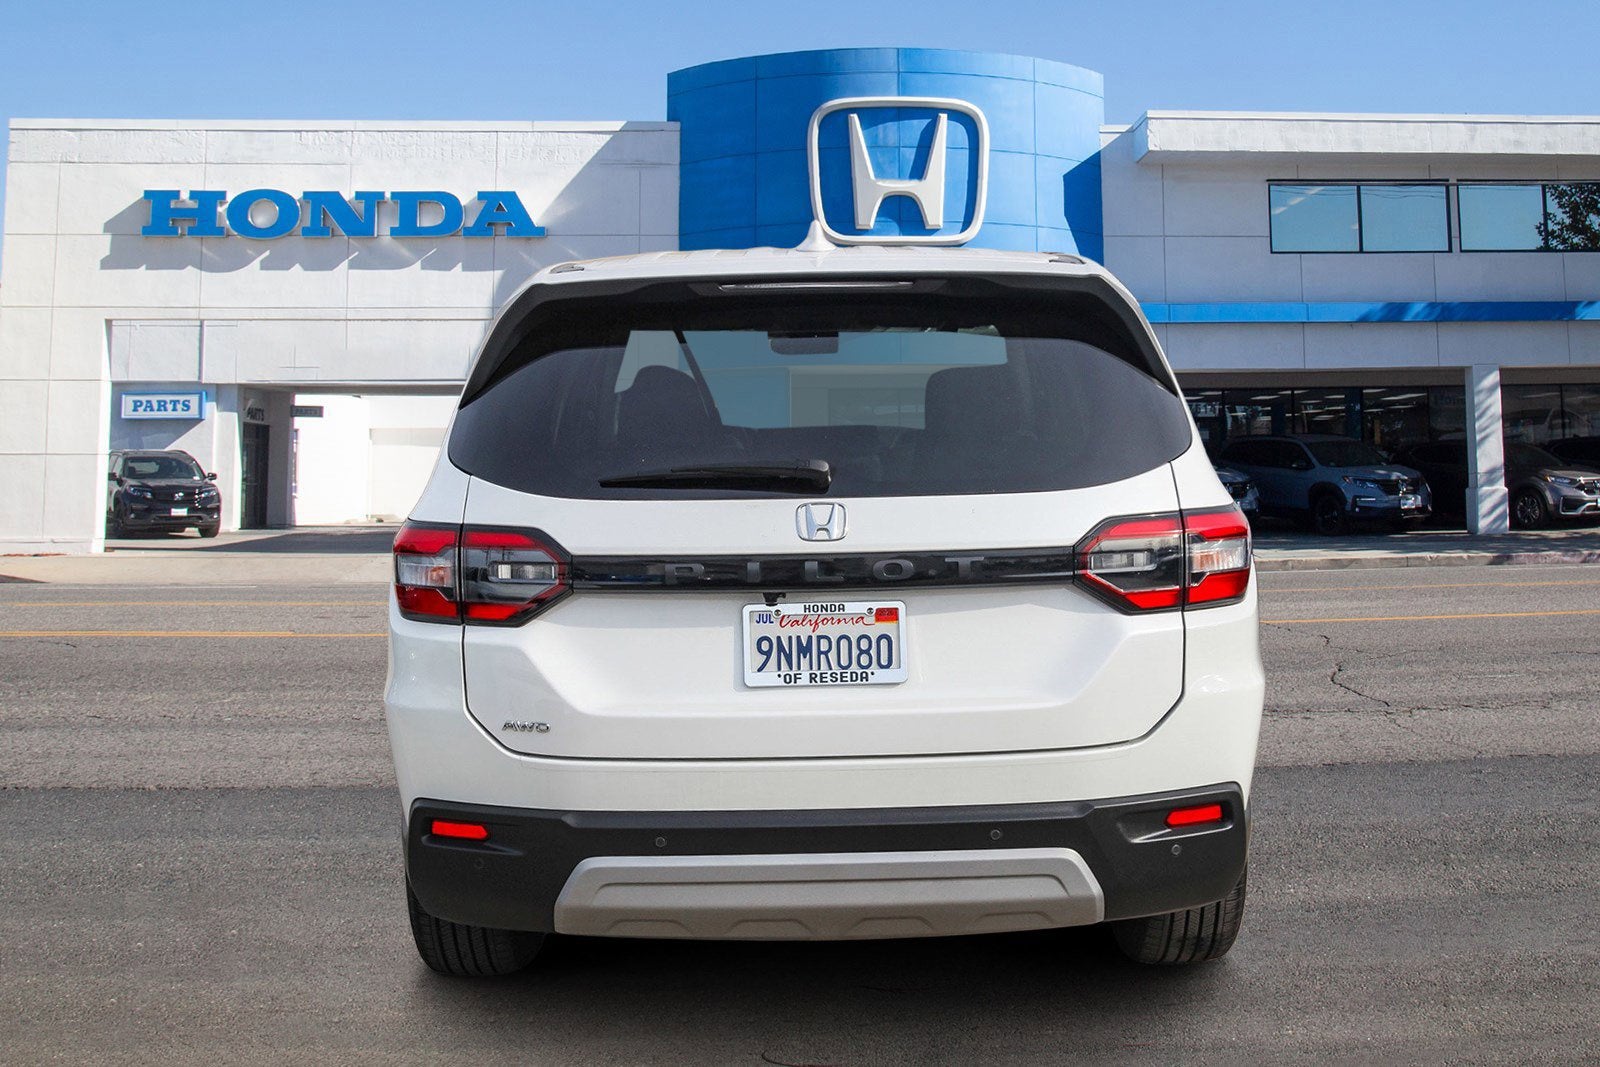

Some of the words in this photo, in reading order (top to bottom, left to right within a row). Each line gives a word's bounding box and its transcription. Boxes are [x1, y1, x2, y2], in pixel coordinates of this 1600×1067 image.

[141, 189, 547, 239] HONDA
[132, 399, 192, 412] PARTS
[664, 556, 984, 585] PILOT
[803, 603, 846, 613] HONDA
[755, 613, 774, 624] JUL
[779, 613, 875, 633] California
[756, 633, 894, 673] 9NMR080
[783, 672, 802, 684] OF
[809, 671, 869, 684] RESEDA
[502, 721, 551, 733] AWD
